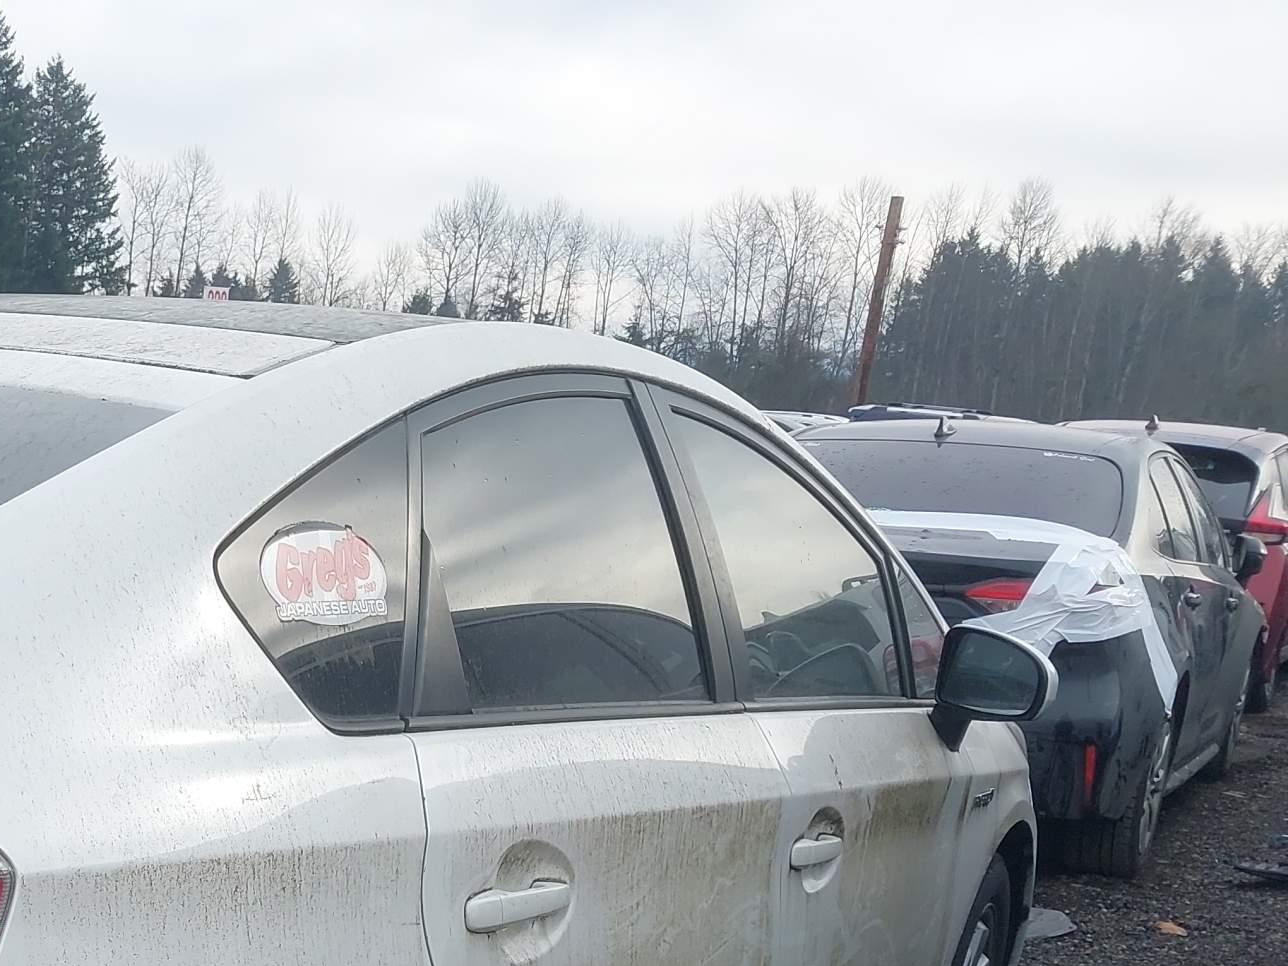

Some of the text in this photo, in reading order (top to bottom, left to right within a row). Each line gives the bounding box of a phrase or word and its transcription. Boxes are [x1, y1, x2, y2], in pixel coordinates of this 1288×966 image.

[275, 524, 370, 601] Greg's
[279, 599, 388, 618] JAPANESE AUTO
